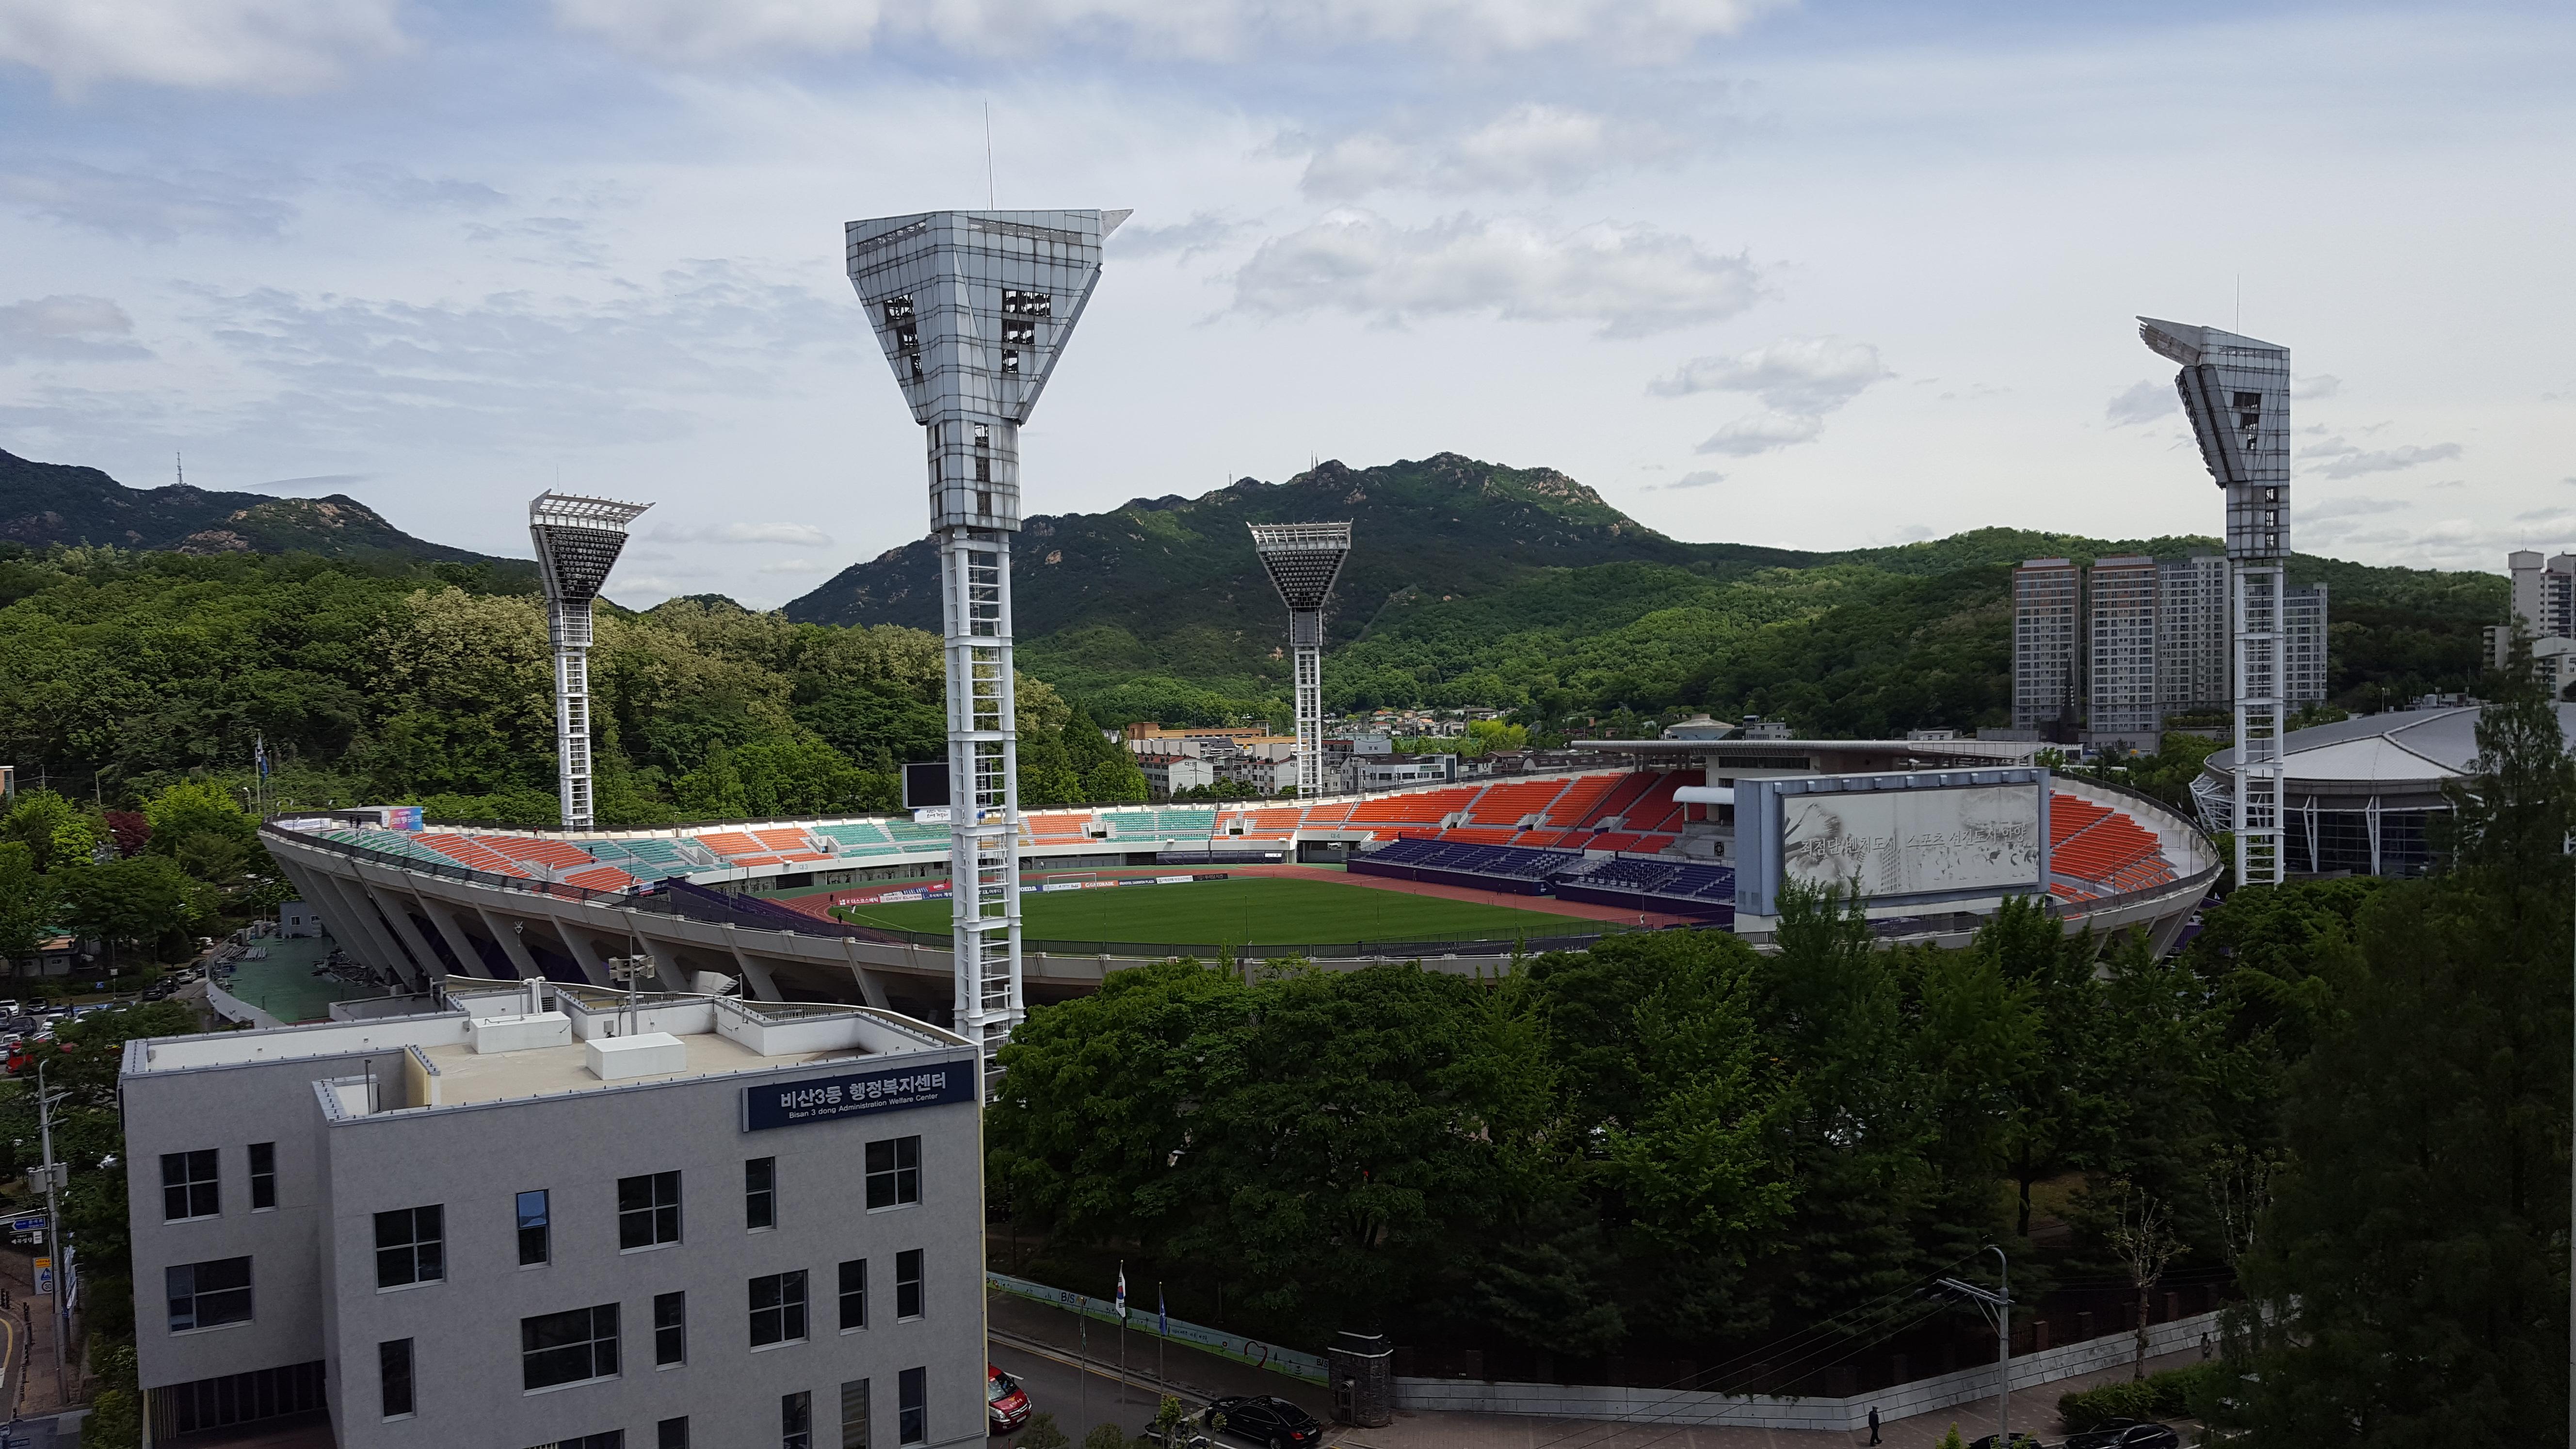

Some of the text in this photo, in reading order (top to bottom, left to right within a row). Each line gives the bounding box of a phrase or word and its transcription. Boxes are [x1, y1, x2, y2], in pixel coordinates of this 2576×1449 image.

[1906, 833, 1945, 848] 스포츠
[1949, 827, 1996, 847] 선진도시
[2002, 824, 2026, 842] 안양
[781, 1072, 946, 1109] 비산3동 행정복지센터
[838, 1100, 887, 1112] Administration
[889, 1097, 913, 1105] Welfare
[916, 1093, 938, 1101] Center
[1317, 1358, 1328, 1367] BIS
